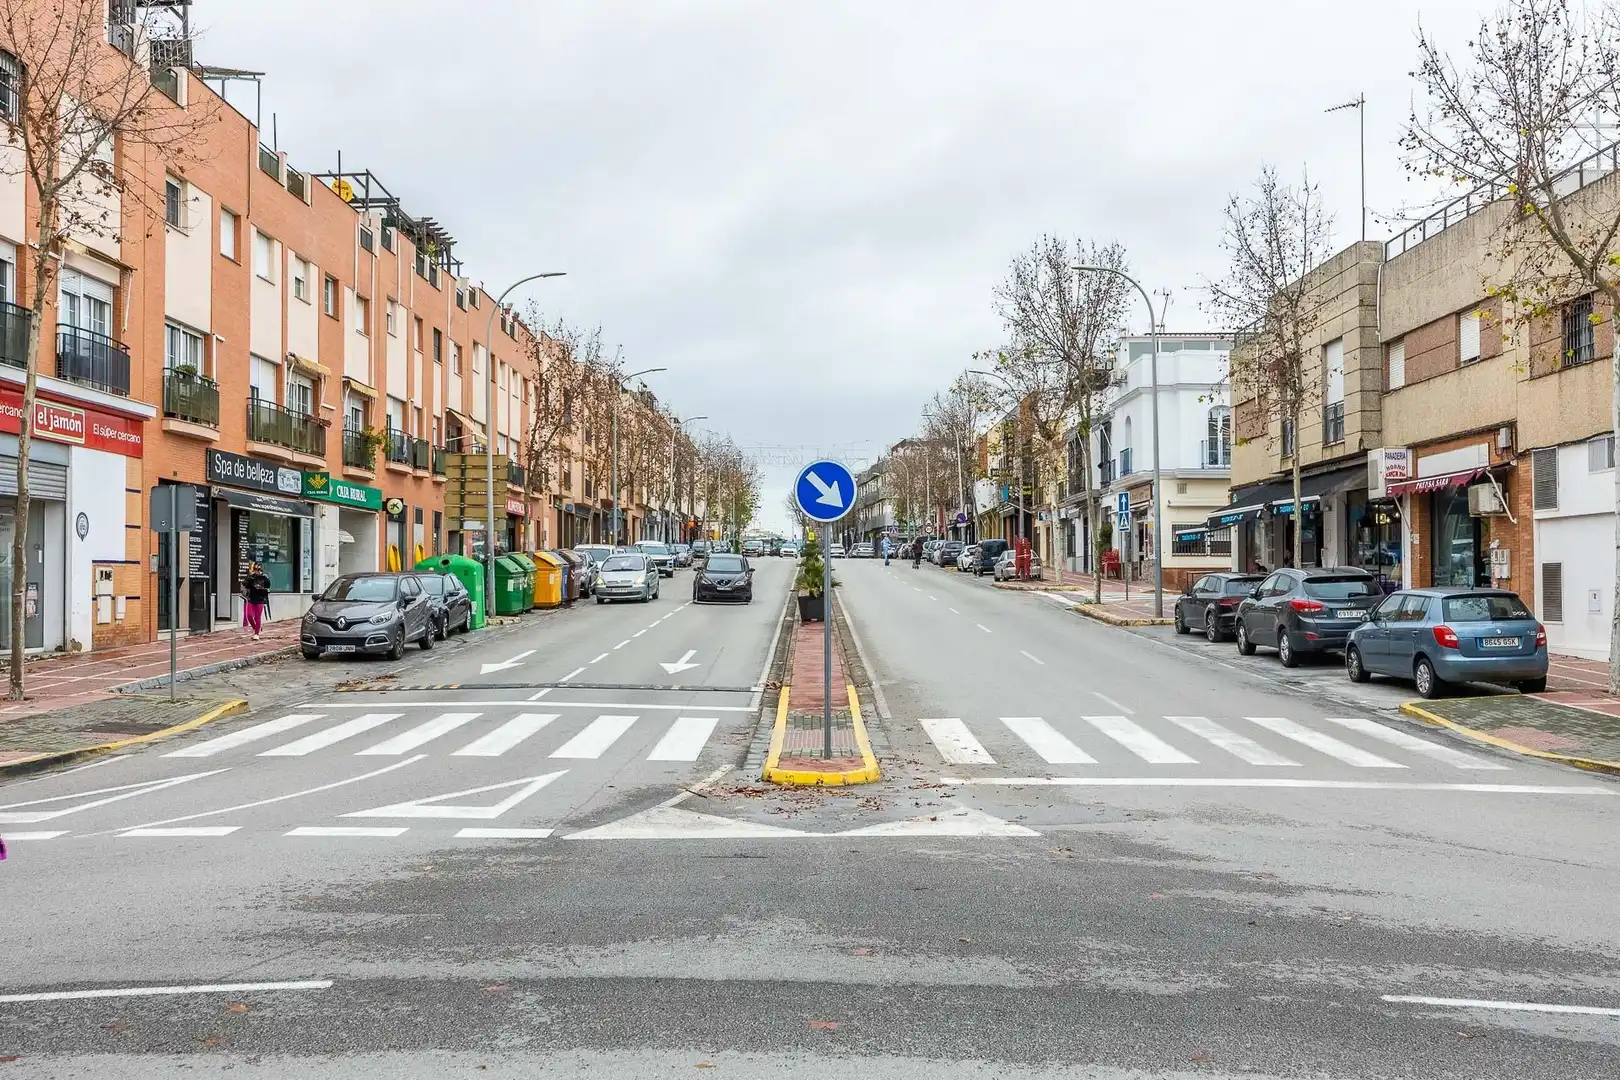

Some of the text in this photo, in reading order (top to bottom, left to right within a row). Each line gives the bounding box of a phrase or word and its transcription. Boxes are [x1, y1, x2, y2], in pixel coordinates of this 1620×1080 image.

[37, 407, 82, 432] el jamón
[93, 423, 141, 444] El súper cercano
[214, 453, 232, 479] Spa
[234, 459, 245, 478] de
[246, 460, 274, 484] belleza
[336, 485, 367, 502] CAJA RURAL
[1484, 638, 1517, 646] 8645 GSK
